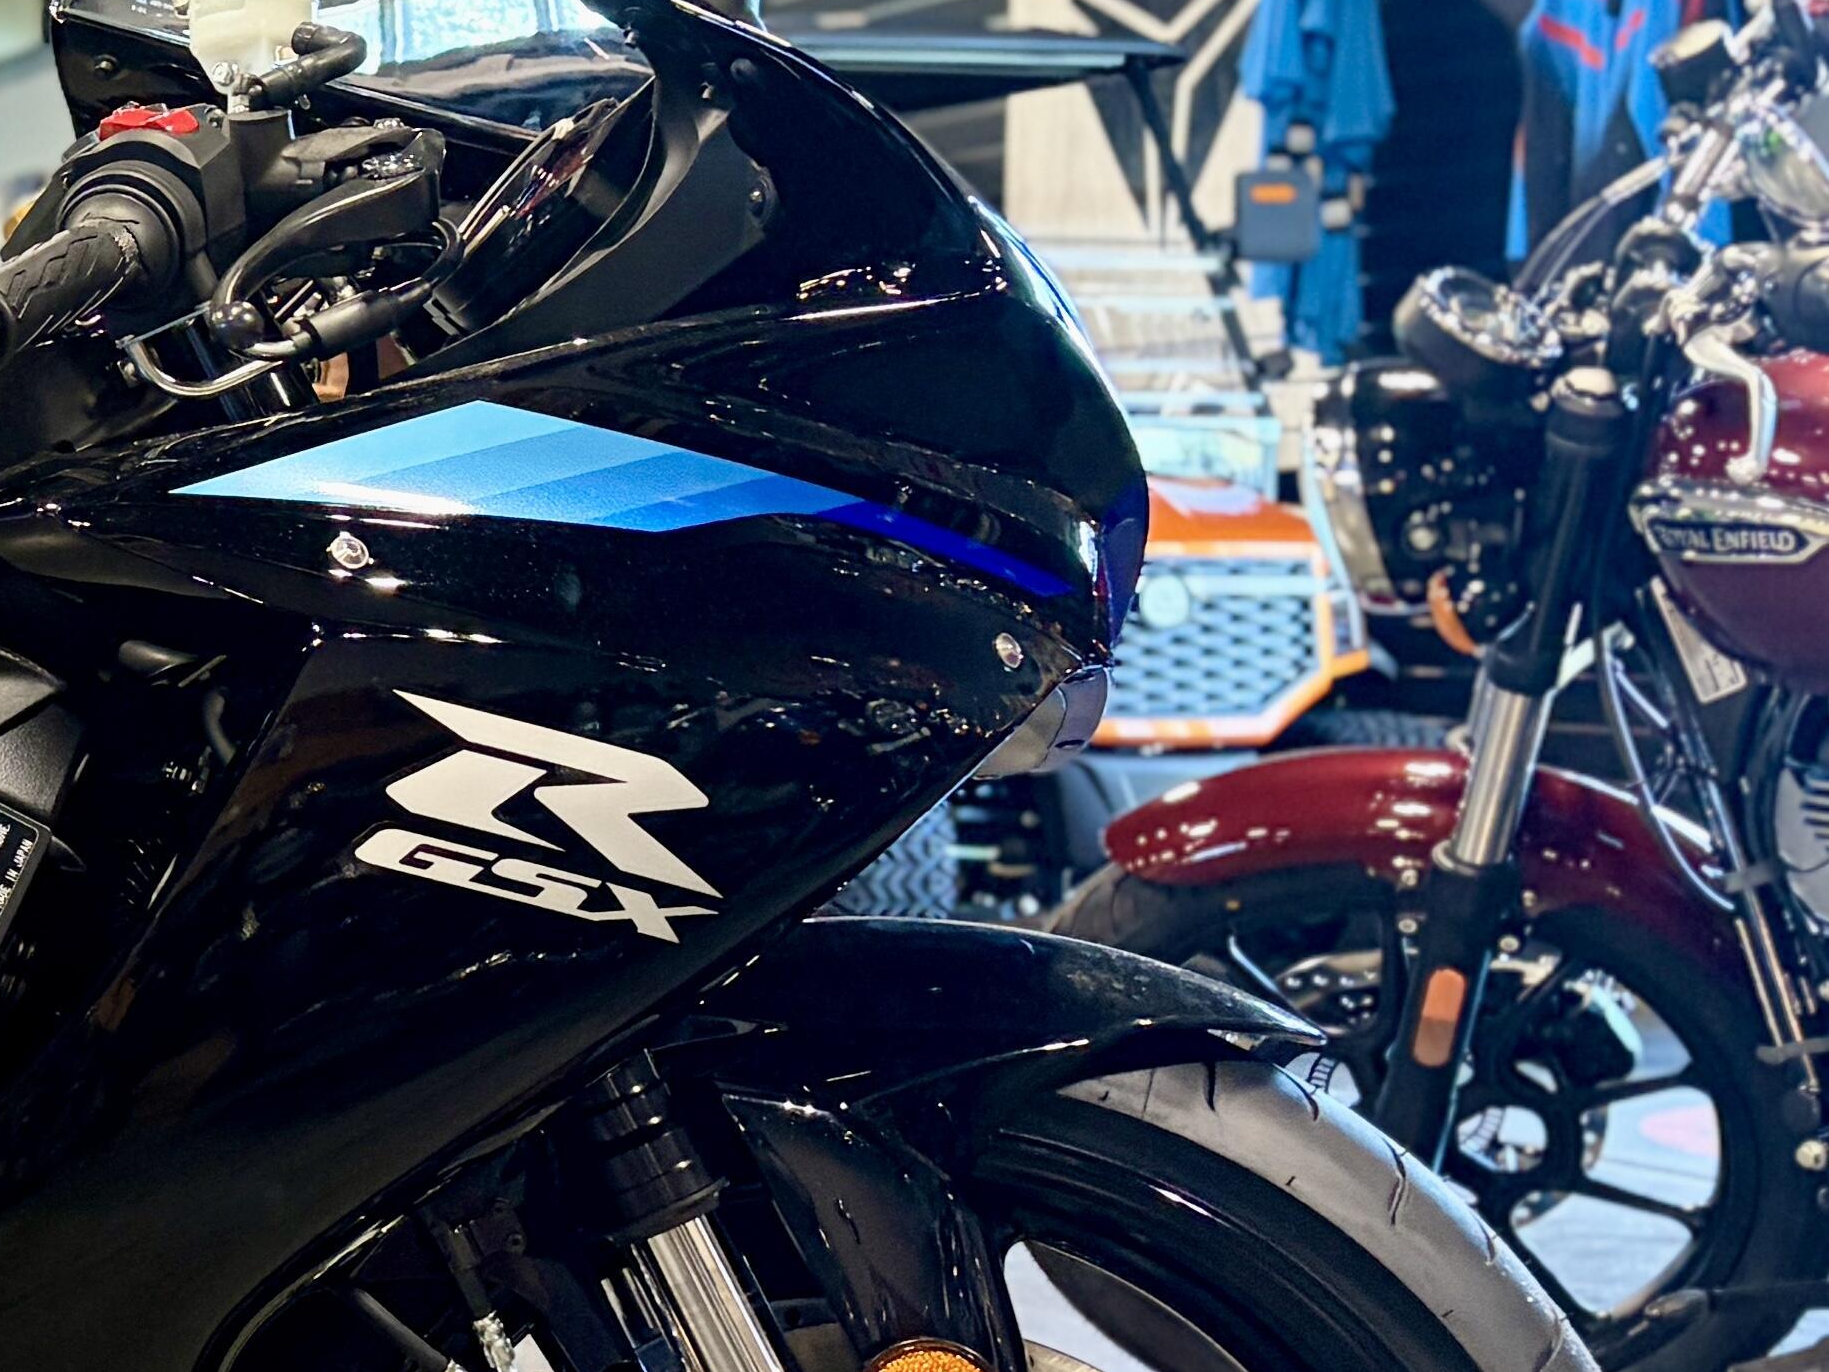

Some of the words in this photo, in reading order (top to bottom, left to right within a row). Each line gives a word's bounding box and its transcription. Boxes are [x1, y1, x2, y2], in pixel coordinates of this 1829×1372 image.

[1711, 527, 1795, 552] ENFIELD
[5, 869, 20, 883] IN
[14, 839, 33, 867] JAPAN
[355, 826, 722, 944] GSX
